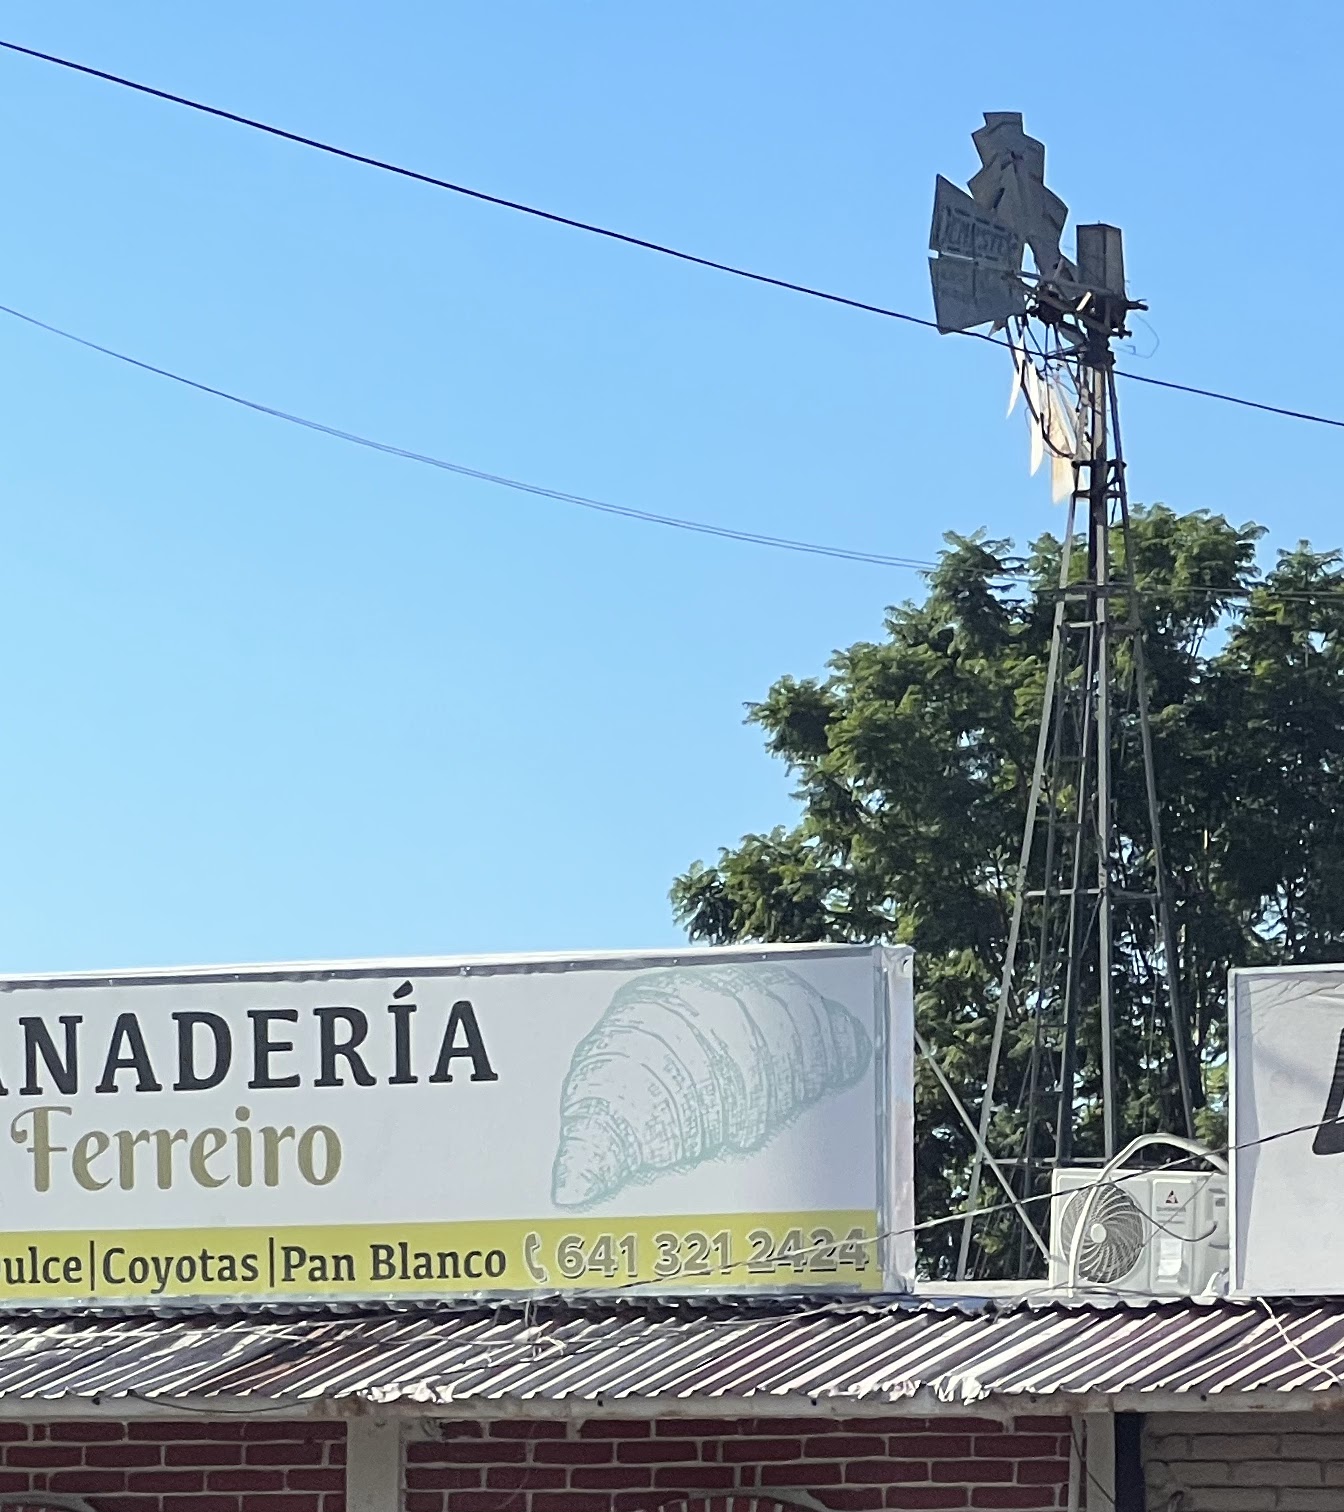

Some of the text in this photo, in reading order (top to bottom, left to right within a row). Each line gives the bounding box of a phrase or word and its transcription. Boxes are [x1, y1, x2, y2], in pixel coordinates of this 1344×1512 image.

[0, 980, 498, 1097] NADERÍA
[10, 1105, 344, 1193] Ferreiro
[369, 1241, 507, 1281] Blanco
[556, 1231, 638, 1280] 641
[653, 1229, 733, 1277] 321
[746, 1226, 869, 1274] 2424
